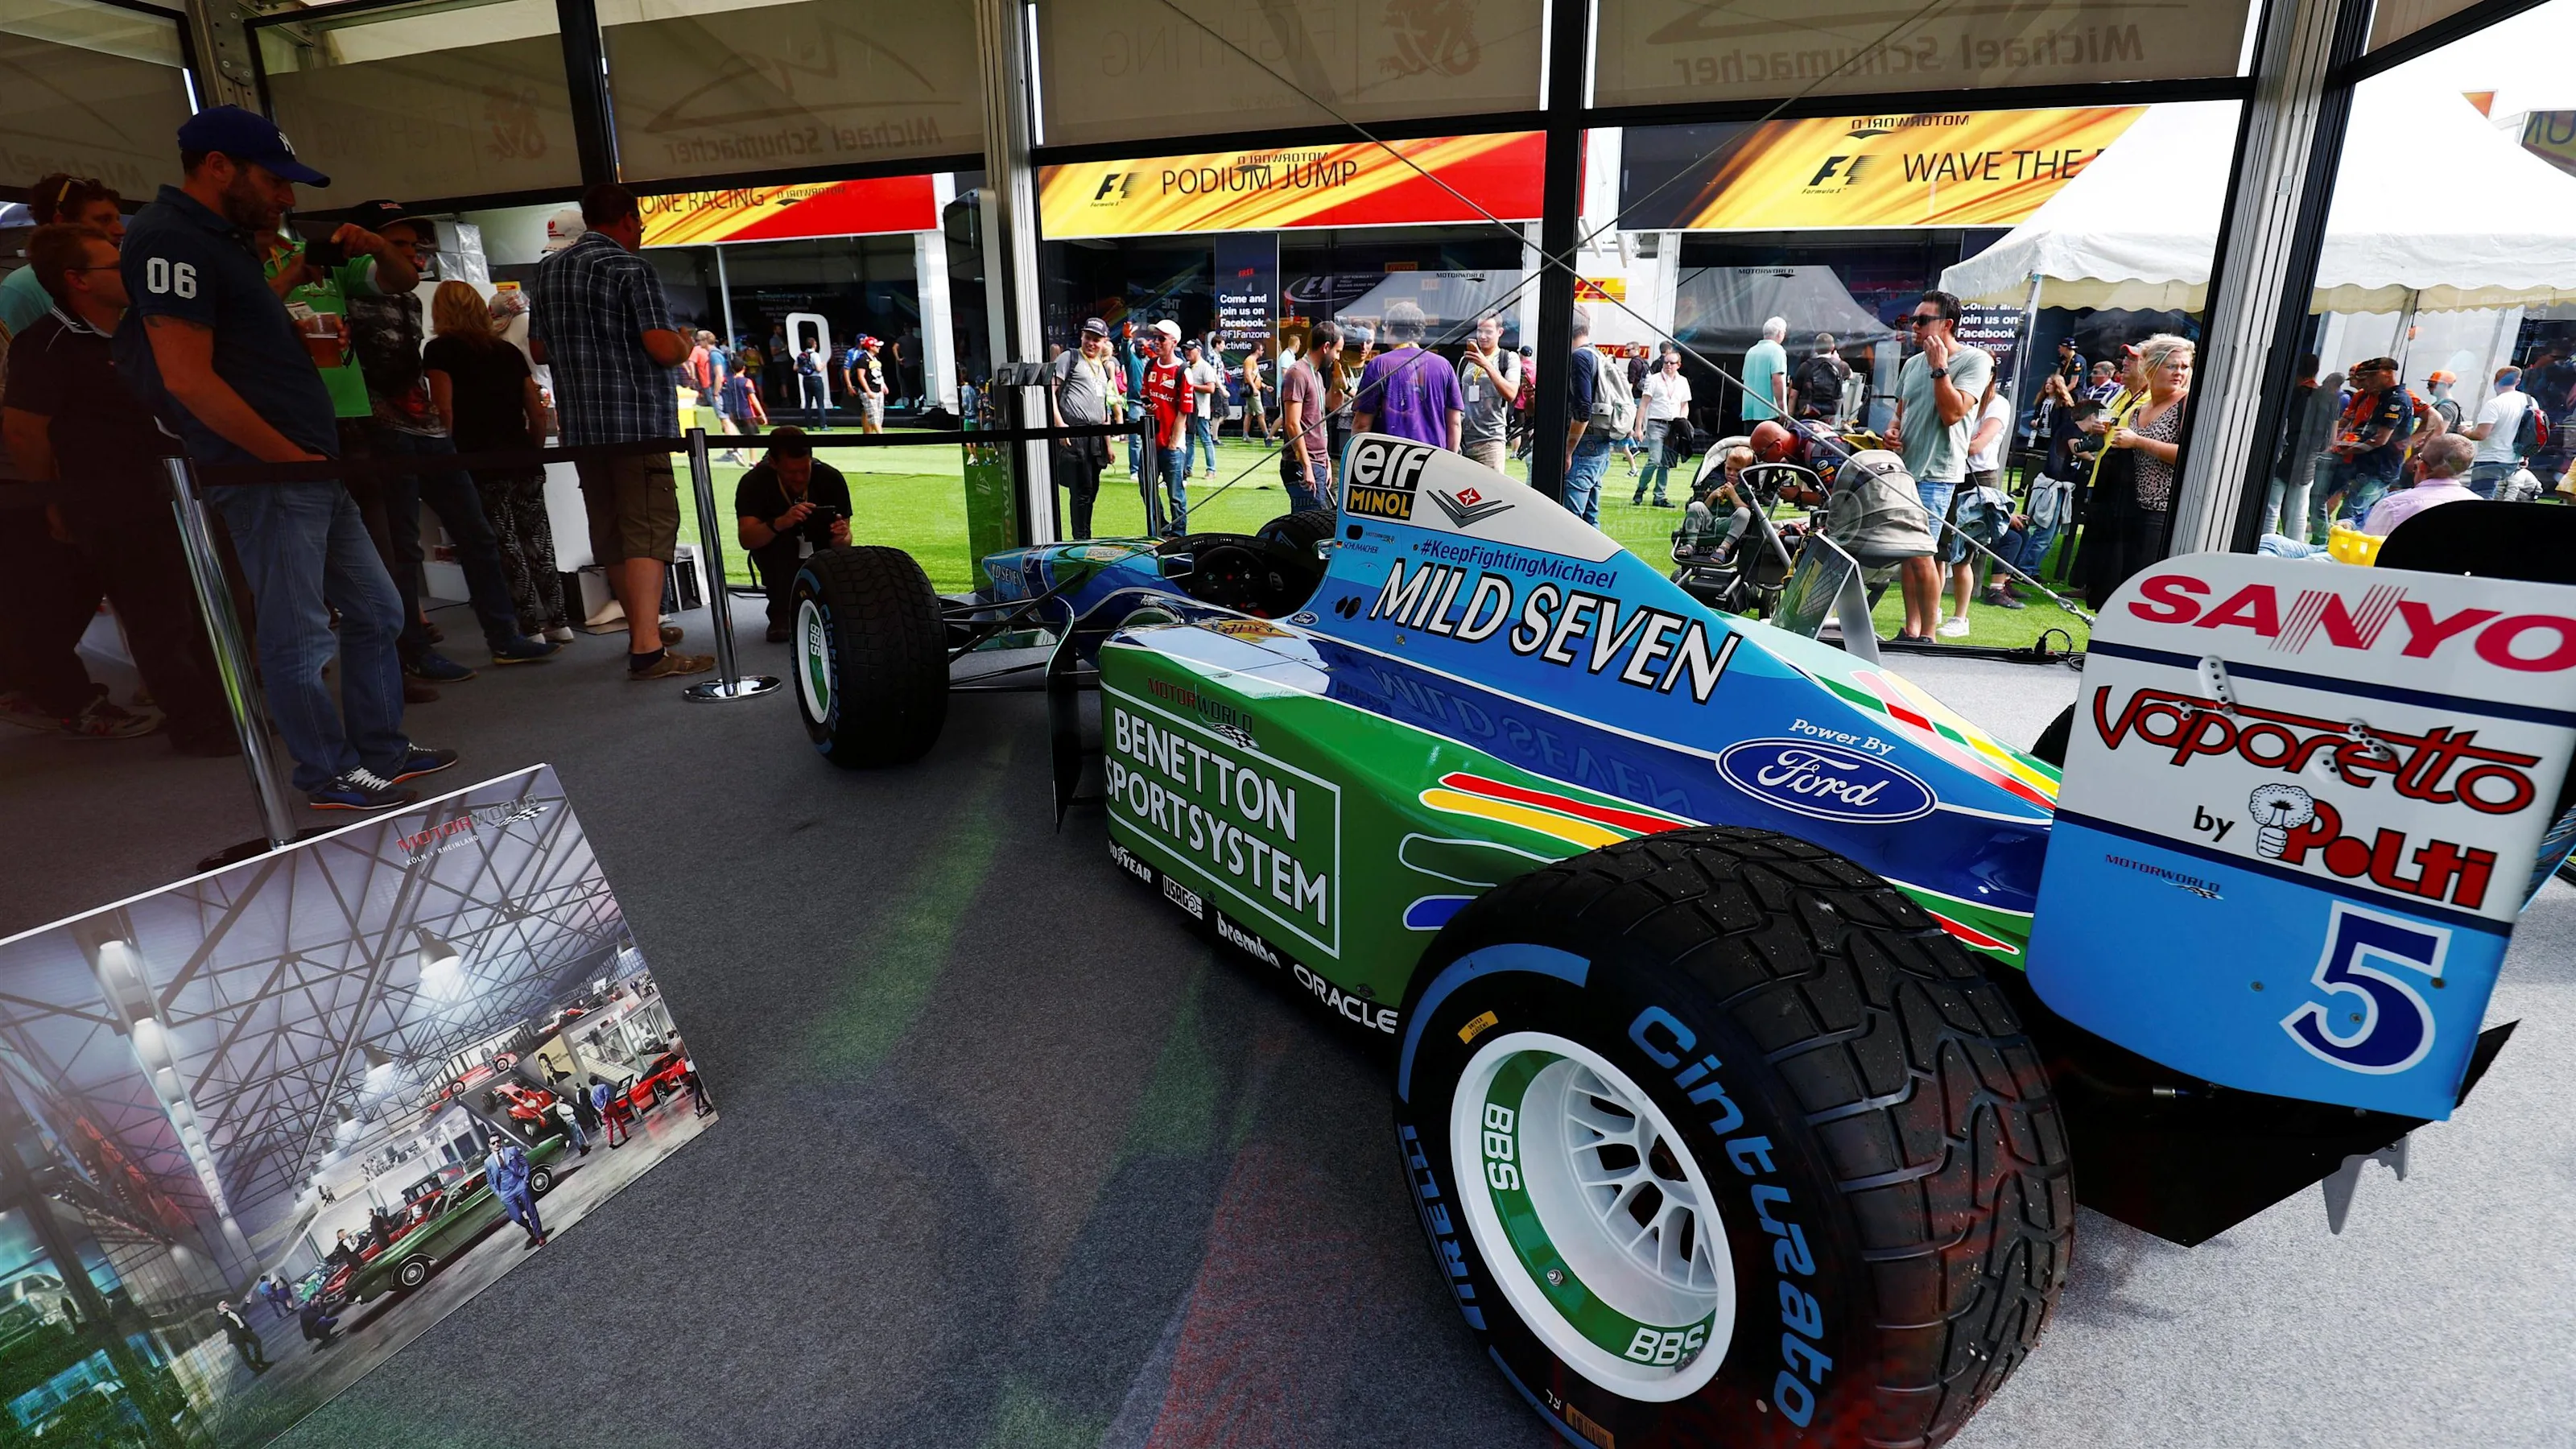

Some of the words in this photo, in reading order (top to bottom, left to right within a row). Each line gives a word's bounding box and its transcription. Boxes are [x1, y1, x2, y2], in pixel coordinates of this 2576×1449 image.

[1162, 164, 1272, 195] PODIUM
[1281, 160, 1357, 189] JUMP
[1903, 151, 2003, 182] WAVE
[2012, 149, 2083, 180] THE
[689, 188, 765, 212] RACING
[147, 257, 197, 299] 06
[1220, 295, 1247, 303] Come
[1249, 294, 1267, 303] and
[1220, 307, 1236, 317] join
[1239, 308, 1250, 316] us
[1253, 308, 1265, 316] on
[1220, 318, 1266, 328] Facebook.
[1959, 314, 1981, 326] join
[1984, 316, 2000, 324] us
[2003, 316, 2018, 324] on
[1220, 330, 1270, 339] @F1Fanzone
[1354, 444, 1433, 487] elf
[1349, 488, 1410, 518] MINOL
[1344, 542, 1379, 554] SCHUMACHER
[1420, 539, 1617, 589] #KeepFightingMichael
[810, 623, 820, 657] BBS
[1368, 558, 1514, 645] MILD
[1509, 581, 1744, 705] SEVEN
[2128, 574, 2576, 672] SANYO
[1148, 677, 1253, 733] MOTORWORLD
[1788, 718, 1861, 745] Power
[1864, 736, 1896, 756] By
[2092, 685, 2543, 815] Vaporetto
[1114, 706, 1297, 842] BENETTON
[1757, 749, 1890, 807] Ford
[396, 793, 539, 853] MOTORWORLD
[2194, 805, 2235, 842] by
[406, 853, 427, 866] KÖLN
[437, 834, 479, 855] RHEINLAND
[2106, 854, 2220, 893] MOTORWORLD
[1217, 910, 1281, 968] brembo
[1293, 964, 1398, 1034] ORACLE
[2280, 899, 2454, 1075] 5
[1483, 1101, 1521, 1192] BBS
[1629, 1005, 1834, 1429] Cinturato
[1624, 1324, 1707, 1366] BBS
